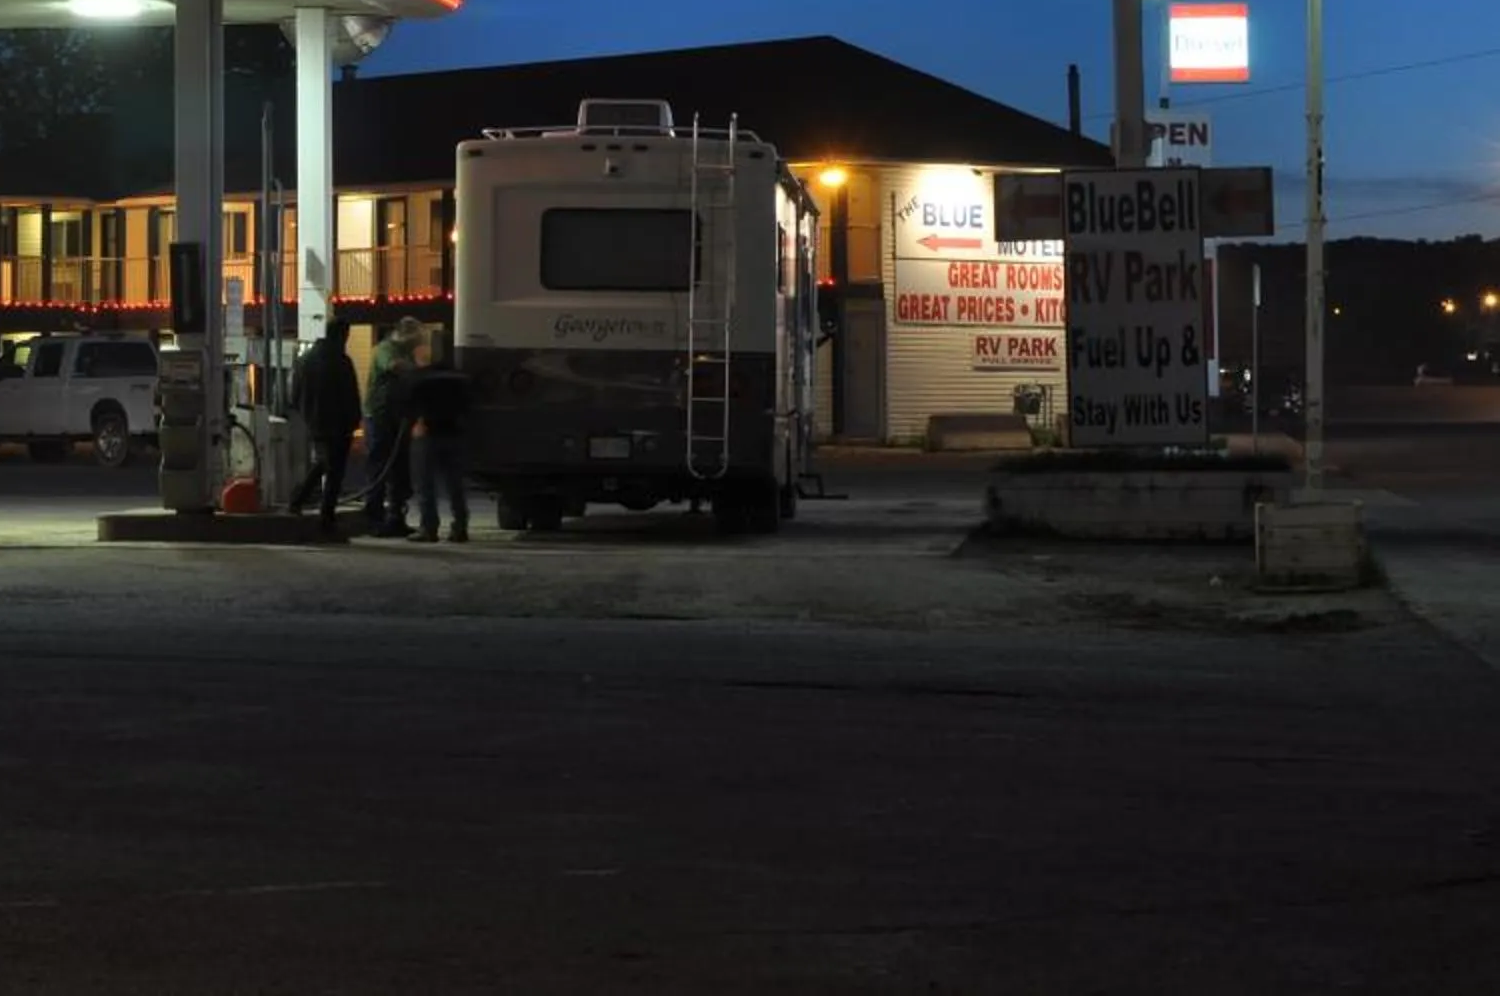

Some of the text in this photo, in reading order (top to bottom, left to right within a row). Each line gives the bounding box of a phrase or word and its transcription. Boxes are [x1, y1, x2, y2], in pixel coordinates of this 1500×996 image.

[1150, 123, 1208, 145] PEN
[899, 195, 920, 221] THE
[922, 203, 984, 229] BLUE
[1067, 178, 1196, 234] BlueBell
[947, 260, 1062, 290] GREAT ROOMS
[1069, 249, 1198, 304] RV Park
[897, 294, 950, 321] GREAT
[956, 296, 1015, 322] PRICES
[976, 336, 1058, 357] RV PARK
[1071, 324, 1199, 378] Fuel Up &
[1074, 393, 1202, 435] Stay With Us
